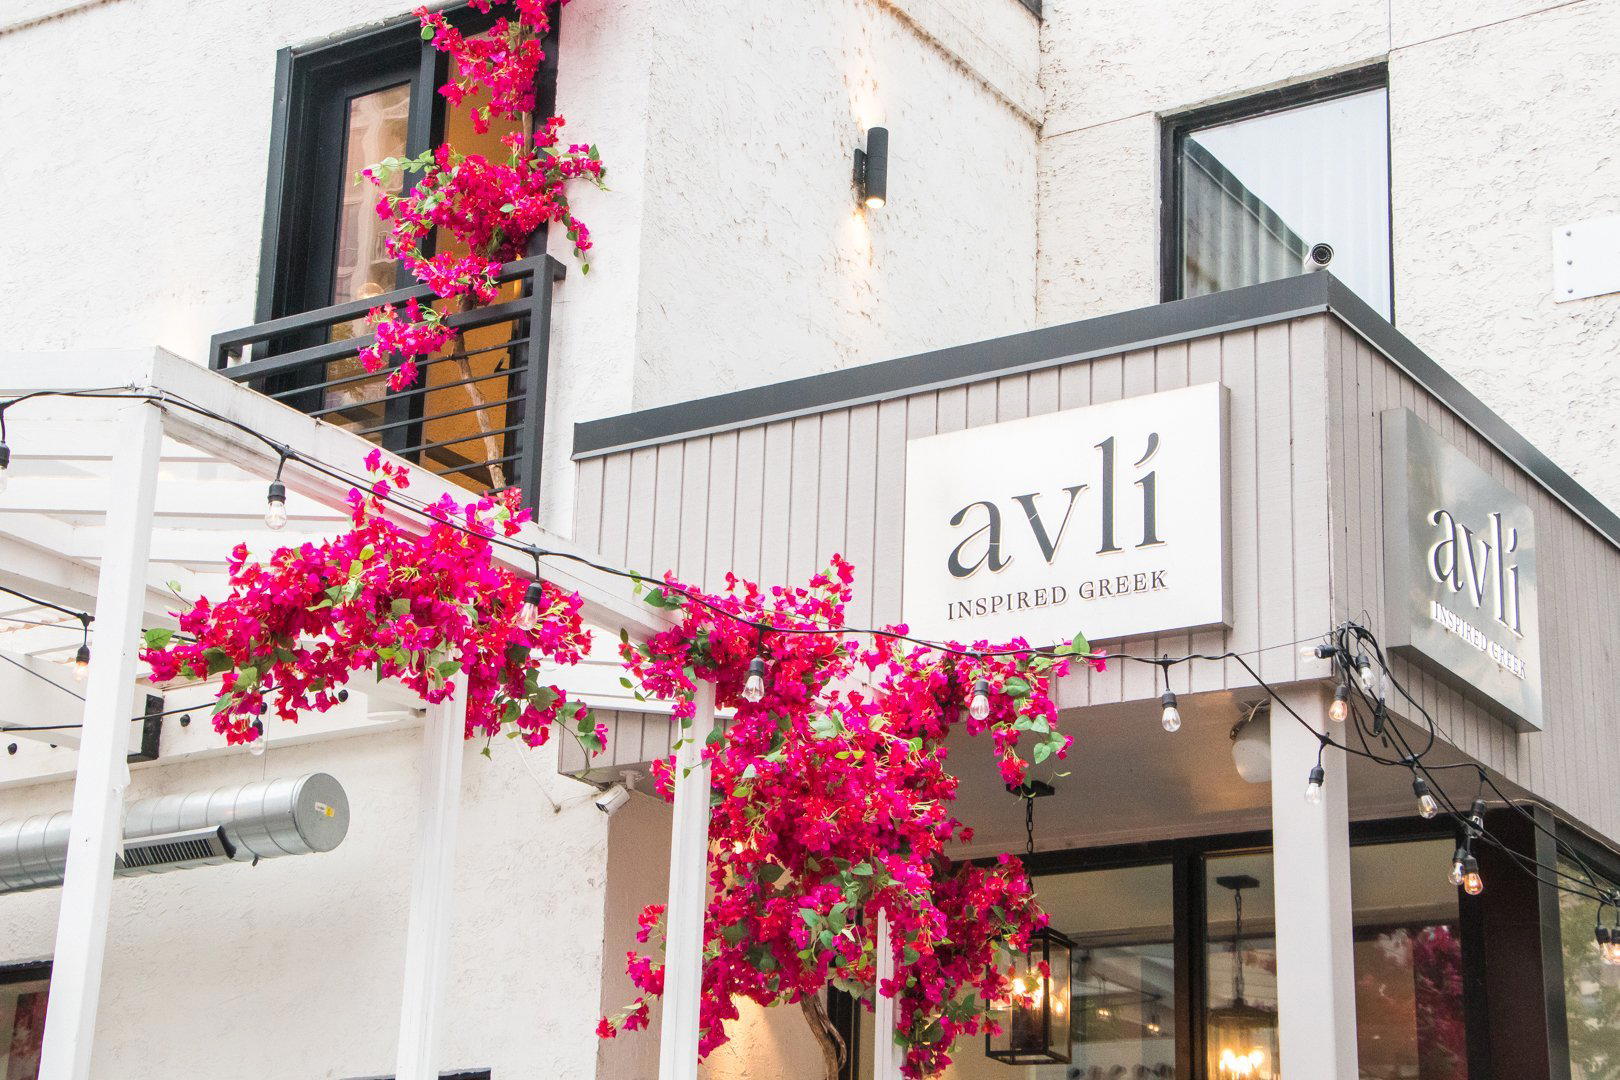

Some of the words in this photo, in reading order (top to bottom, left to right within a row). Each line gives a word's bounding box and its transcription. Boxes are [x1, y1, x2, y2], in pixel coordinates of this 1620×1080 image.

[948, 585, 1067, 621] INSPIRED
[1078, 570, 1168, 601] GREEK
[1430, 600, 1488, 652] INSPIRED
[1488, 641, 1527, 680] GREEK
